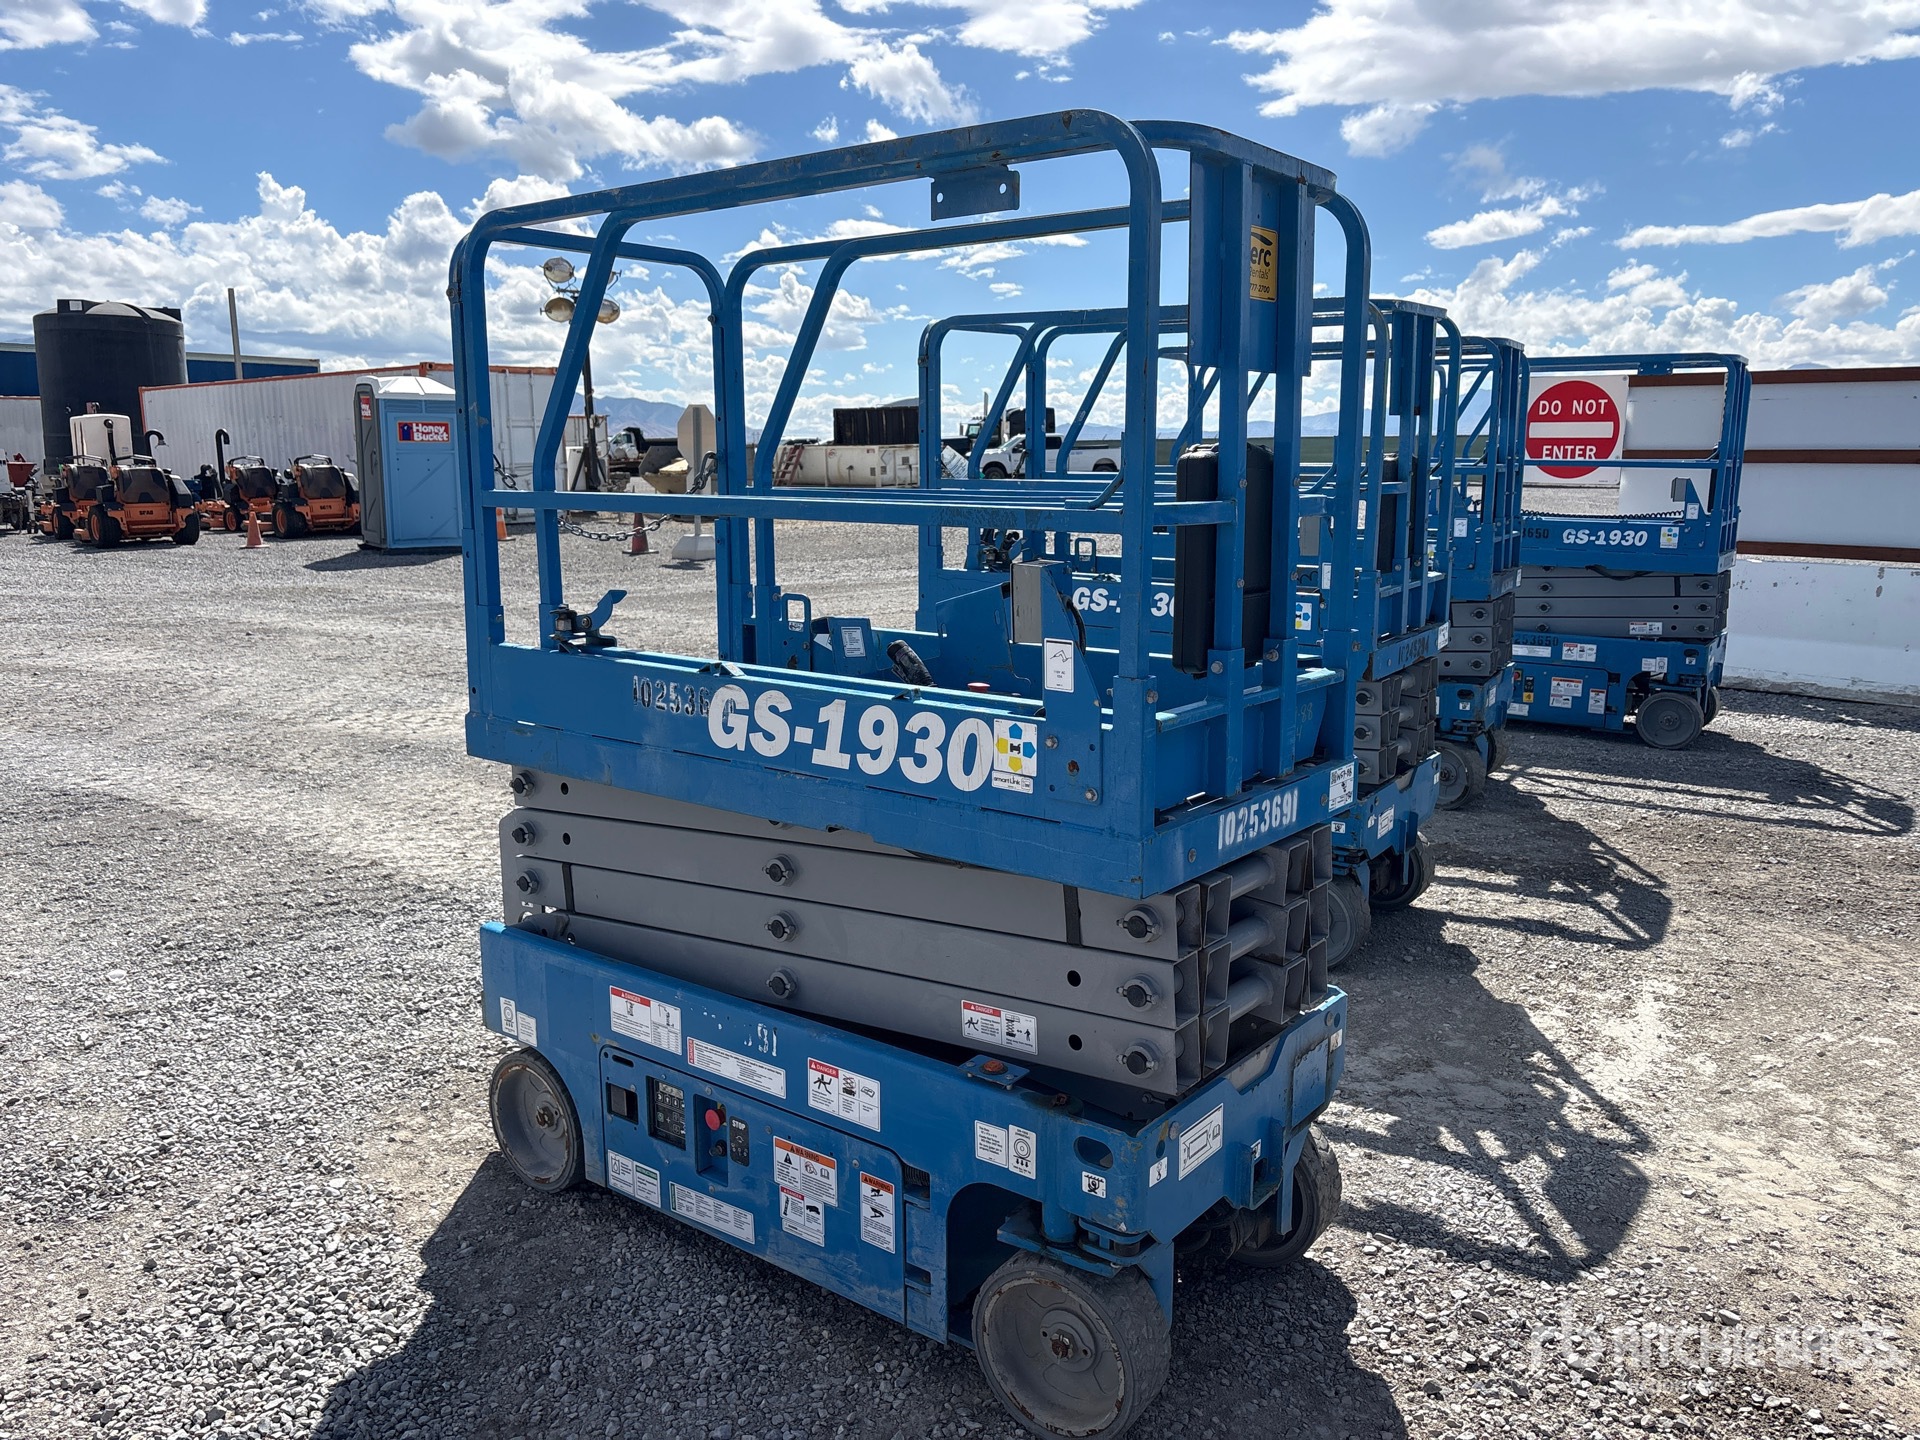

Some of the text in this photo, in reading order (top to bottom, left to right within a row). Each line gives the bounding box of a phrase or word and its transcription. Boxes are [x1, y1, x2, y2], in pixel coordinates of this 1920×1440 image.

[1251, 246, 1271, 267] erc
[1250, 267, 1270, 279] entals
[1538, 399, 1608, 415] DO NOT
[412, 422, 446, 435] Honey
[413, 432, 449, 441] Bucket
[1541, 445, 1597, 460] ENTER
[1562, 528, 1649, 547] GS-1930
[707, 684, 994, 792] GS-1930
[1218, 788, 1299, 850] 10253691
[975, 1005, 994, 1015] DANGER
[816, 1064, 837, 1075] DANGER
[731, 1119, 746, 1131] STOP
[794, 1146, 820, 1162] WARNING
[868, 1178, 891, 1192] WARNING
